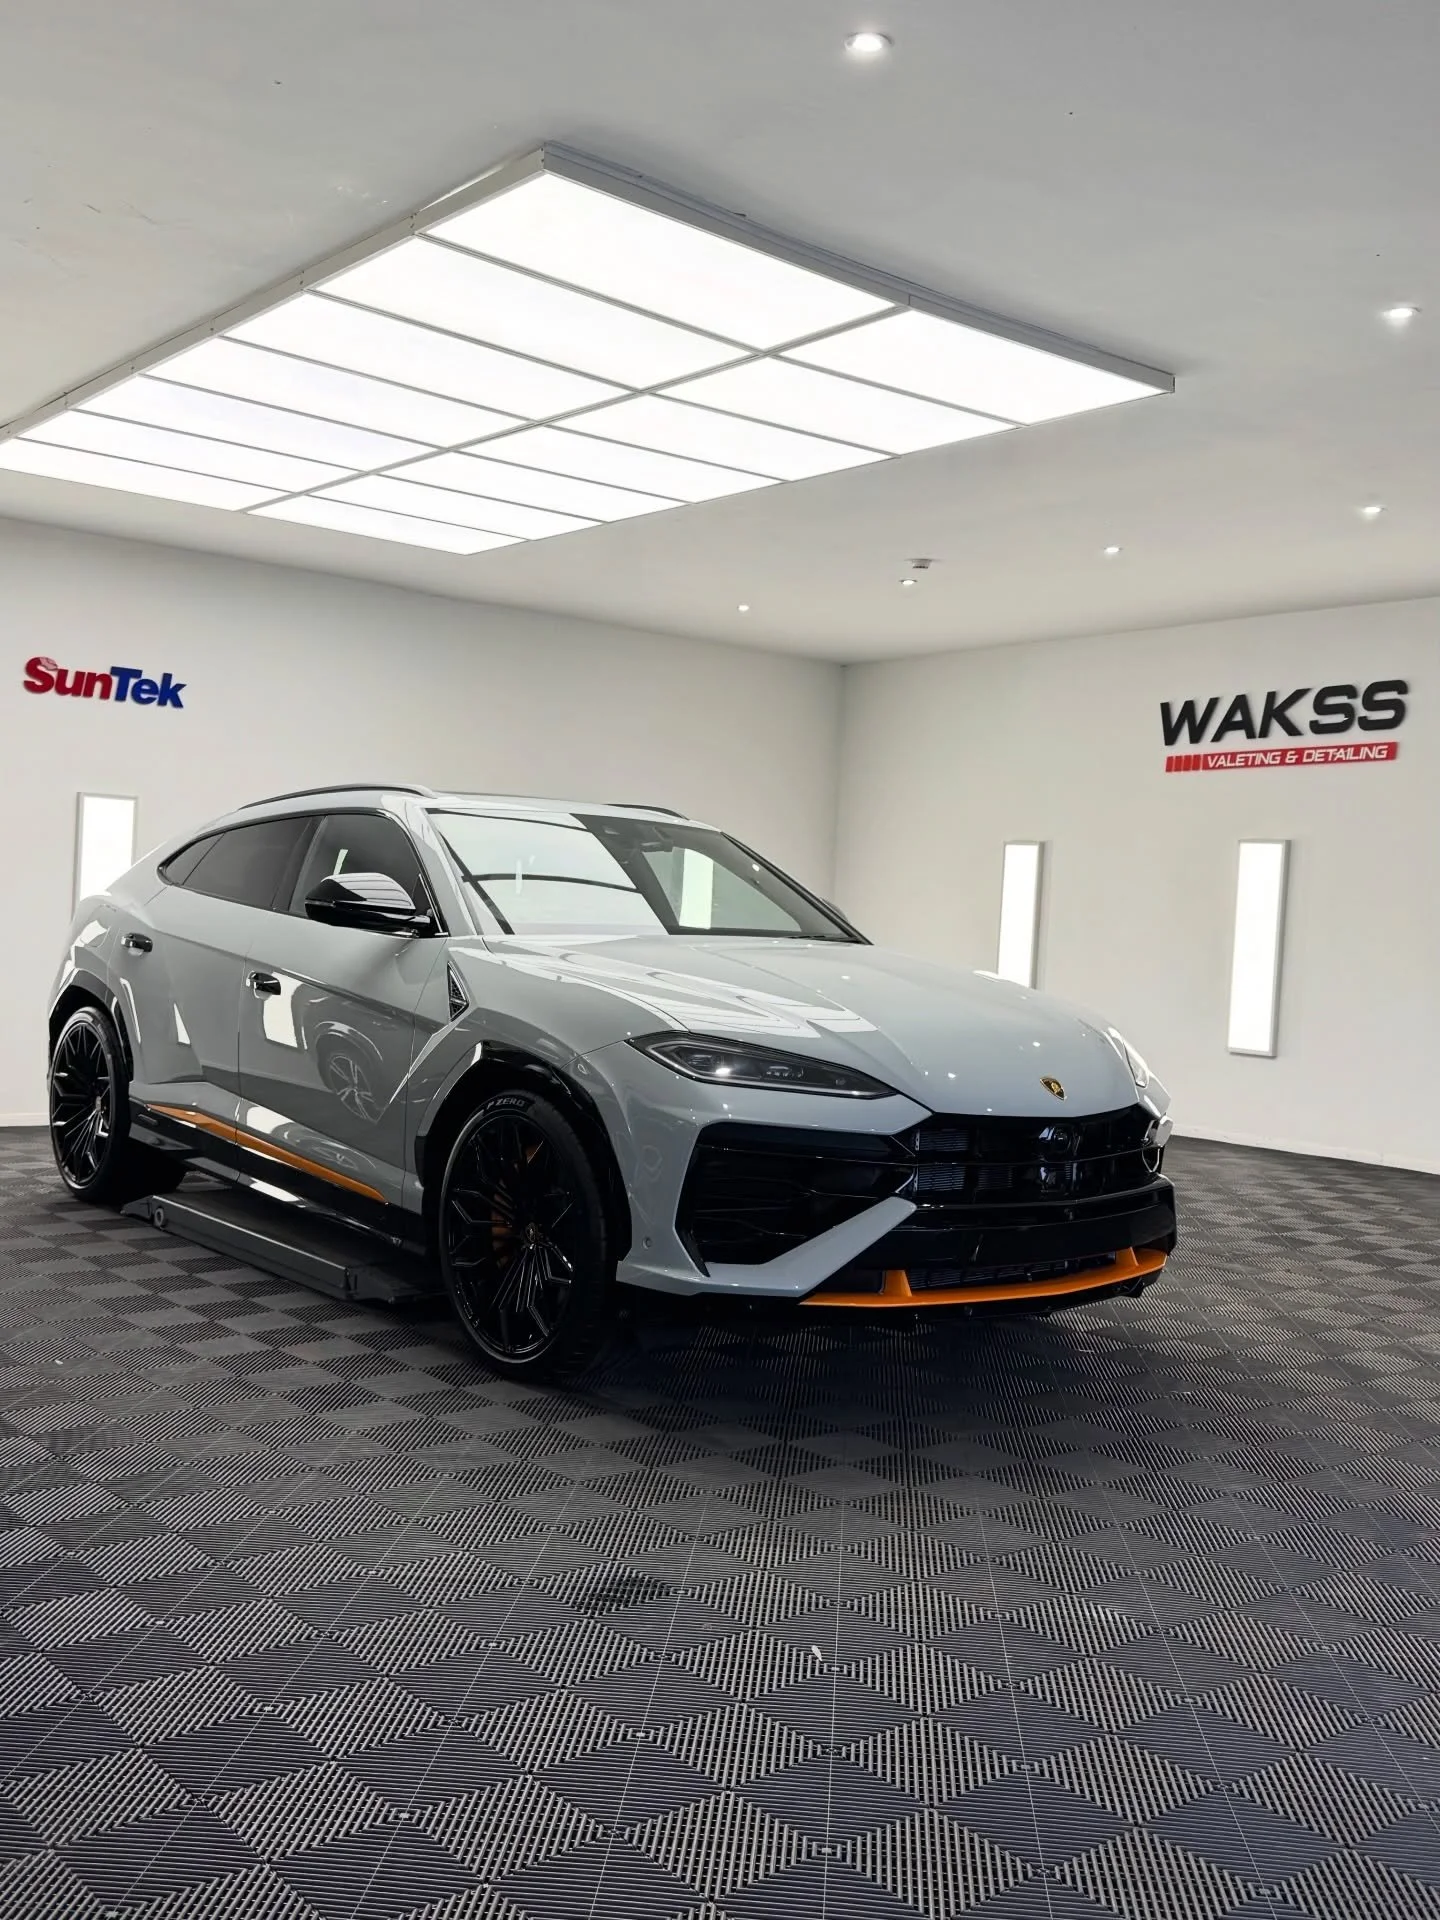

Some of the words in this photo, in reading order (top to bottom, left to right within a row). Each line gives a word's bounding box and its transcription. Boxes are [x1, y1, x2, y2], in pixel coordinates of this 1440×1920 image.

[23, 656, 187, 708] SunTek
[1160, 679, 1409, 746] WAKSS
[1207, 751, 1280, 769] VALETING
[1285, 751, 1298, 764] &
[1302, 745, 1388, 763] DETAILING
[495, 1097, 526, 1107] ZERO
